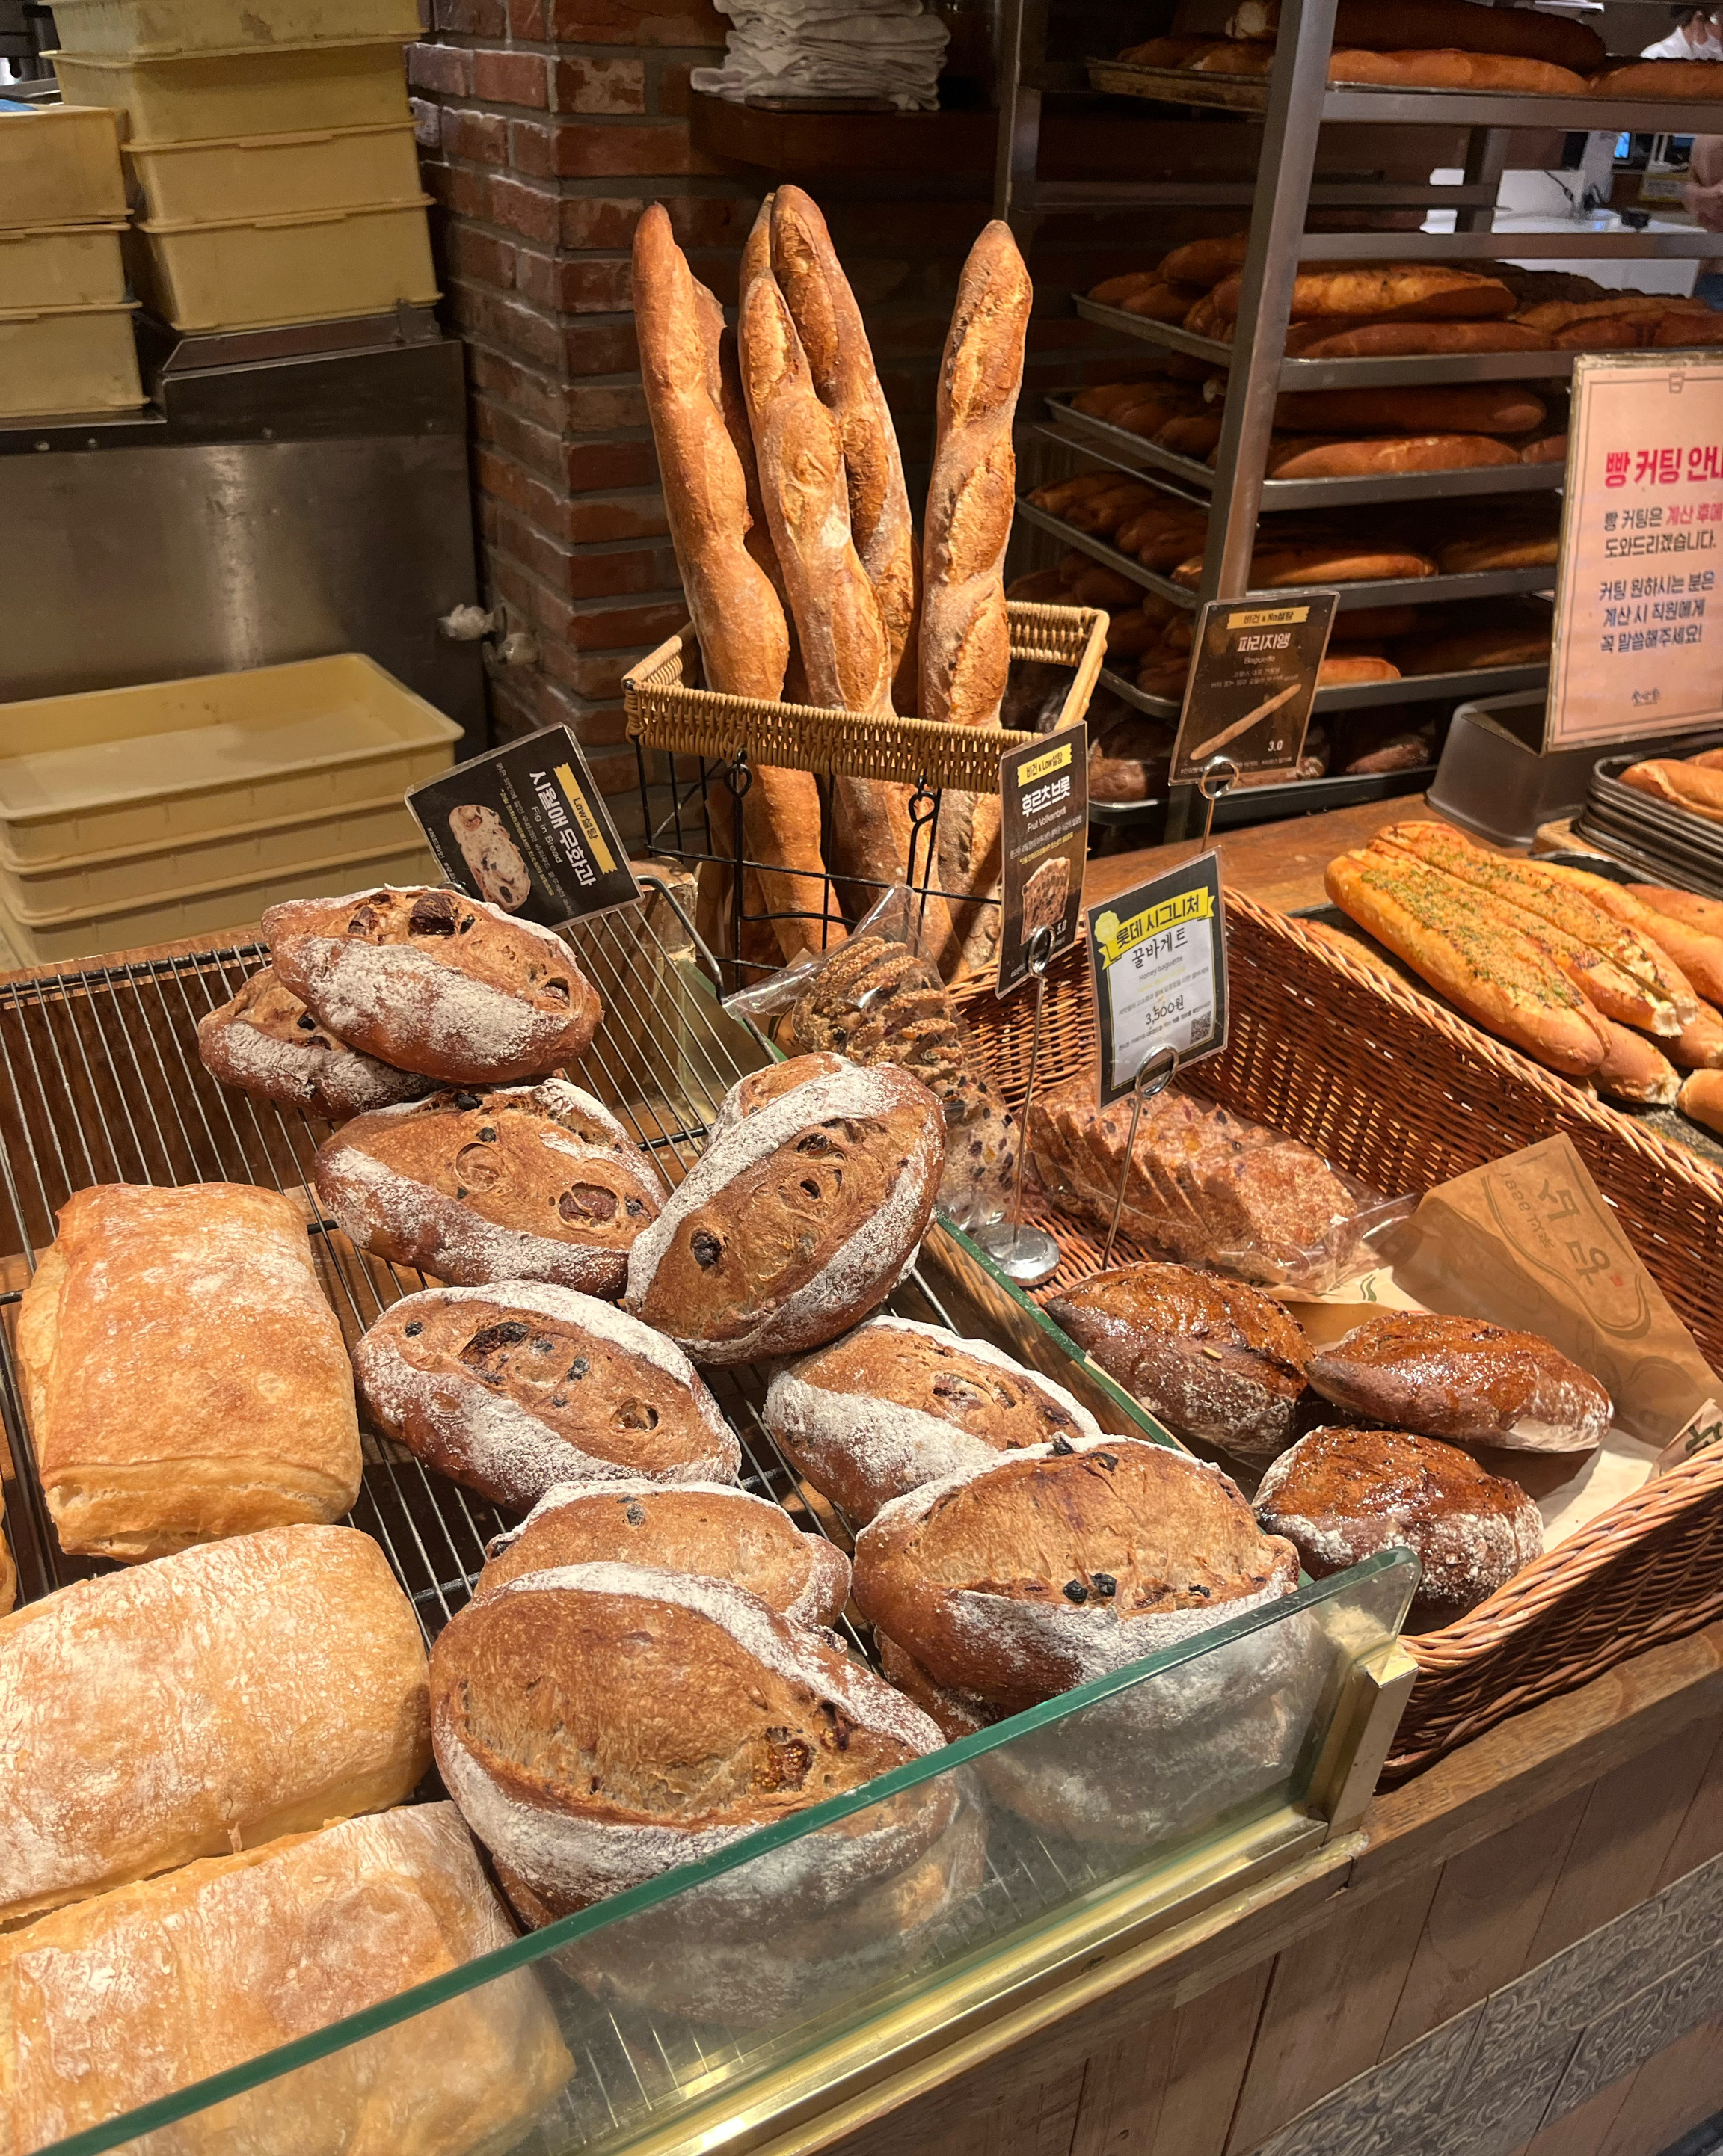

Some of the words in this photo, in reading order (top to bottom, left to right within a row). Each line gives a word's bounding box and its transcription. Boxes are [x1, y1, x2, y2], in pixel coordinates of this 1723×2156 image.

[1605, 452, 1630, 488] 빵
[1634, 448, 1682, 485] 커팅
[1604, 511, 1618, 532] 빵
[1621, 506, 1662, 529] 커팅은
[1666, 503, 1694, 526] 계산
[1605, 529, 1717, 559] 도와드리겠습니다.
[1599, 579, 1627, 601] 커팅
[1630, 574, 1684, 599] 원하시는
[1688, 570, 1715, 592] 분은
[1244, 614, 1261, 624] 비건
[1603, 605, 1631, 627] 계산
[1633, 603, 1648, 624] 시
[1652, 598, 1705, 622] 직원에게
[1238, 633, 1291, 652] 파리지앵
[1600, 634, 1614, 654] 꼭
[1618, 624, 1702, 653] 말씀해주세요!
[1267, 739, 1283, 752] 3.0
[1026, 762, 1038, 778] 비건
[1042, 752, 1063, 771] Low설탕
[1022, 785, 1051, 817] 후르츠
[1051, 775, 1071, 804] 브롯
[529, 771, 569, 829] 시월애
[559, 828, 597, 887] 무화과
[573, 797, 599, 840] Low설탕
[1027, 818, 1038, 832] Fruit
[427, 827, 445, 859] #레드와인
[531, 806, 542, 823] Fig
[540, 825, 548, 834] in
[545, 835, 563, 864] Bread
[1056, 919, 1067, 935] 5.0
[1116, 918, 1143, 949] 롯데
[1146, 894, 1199, 931] 시그니처
[1131, 927, 1188, 968] 꿀바게트
[1138, 968, 1157, 981] Honey
[1157, 955, 1183, 974] baguette
[1146, 995, 1184, 1025] 3,500원
